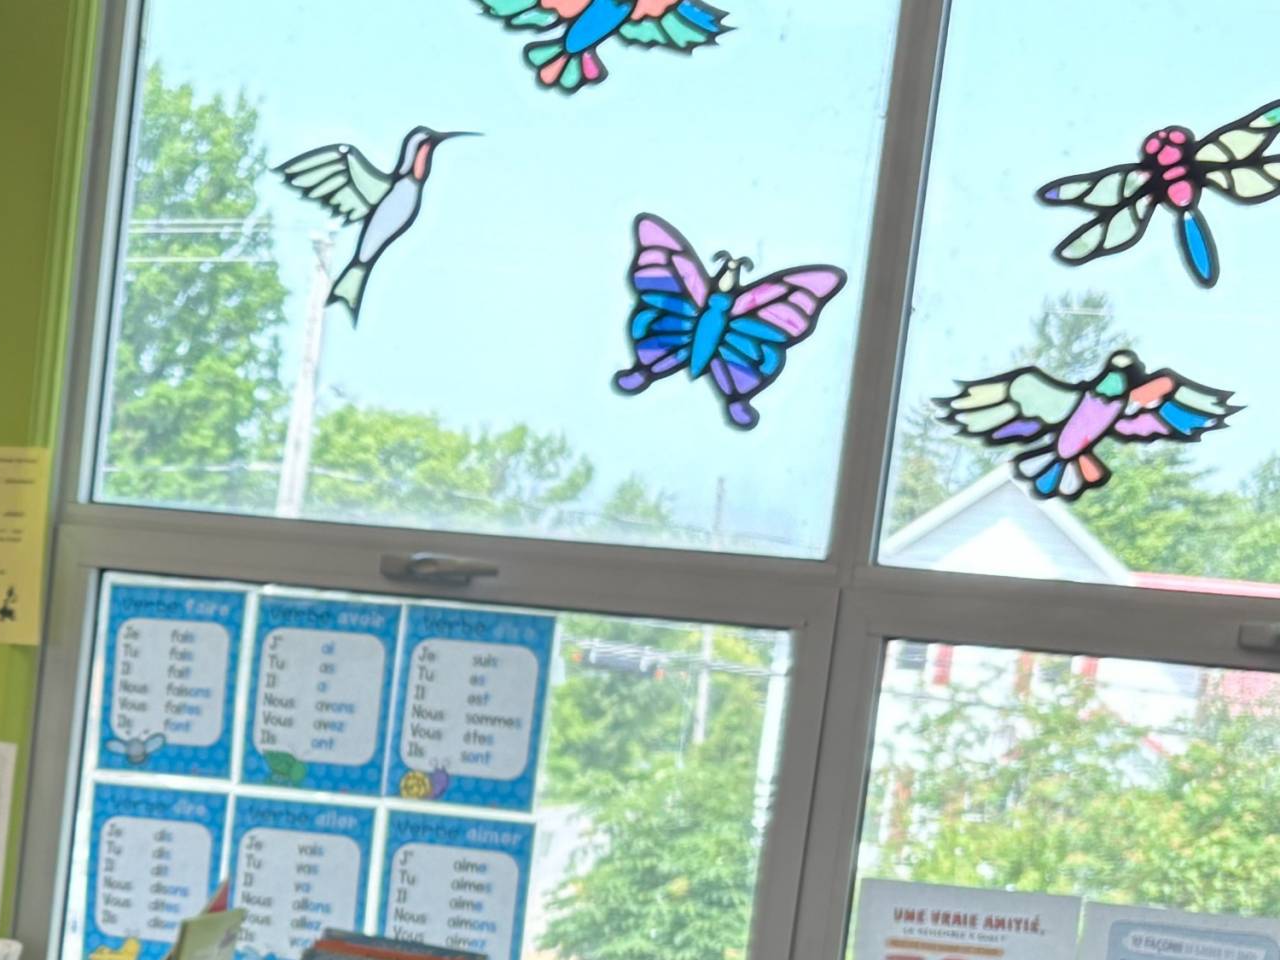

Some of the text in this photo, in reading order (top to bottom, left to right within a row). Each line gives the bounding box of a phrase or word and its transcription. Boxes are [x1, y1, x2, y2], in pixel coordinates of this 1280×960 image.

[321, 641, 335, 655] ai
[419, 647, 498, 667] Je suis
[270, 654, 335, 674] Tu as
[418, 665, 486, 686] Tu es
[120, 680, 149, 694] Nous
[317, 682, 327, 693] a
[415, 684, 490, 705] Il est
[119, 697, 147, 711] Vous
[264, 693, 355, 714] Nous avons
[263, 710, 345, 733] Vous avez
[412, 704, 522, 730] Nous sommes
[261, 729, 334, 750] Ils ont
[410, 723, 442, 741] Vous
[407, 741, 491, 764] Ils sont
[246, 836, 325, 857] Je vais
[466, 827, 522, 846] aimer
[246, 853, 319, 876] Tu vas
[453, 857, 488, 873] aime
[294, 881, 312, 893] va
[400, 869, 492, 894] Tu aimes
[241, 891, 333, 914] Nous allons
[397, 887, 484, 912] Il aime
[290, 914, 322, 931] allez
[394, 907, 496, 932] Nous aimons
[894, 906, 926, 924] UNE
[931, 909, 978, 928] VRAIE
[446, 933, 487, 949] aimez
